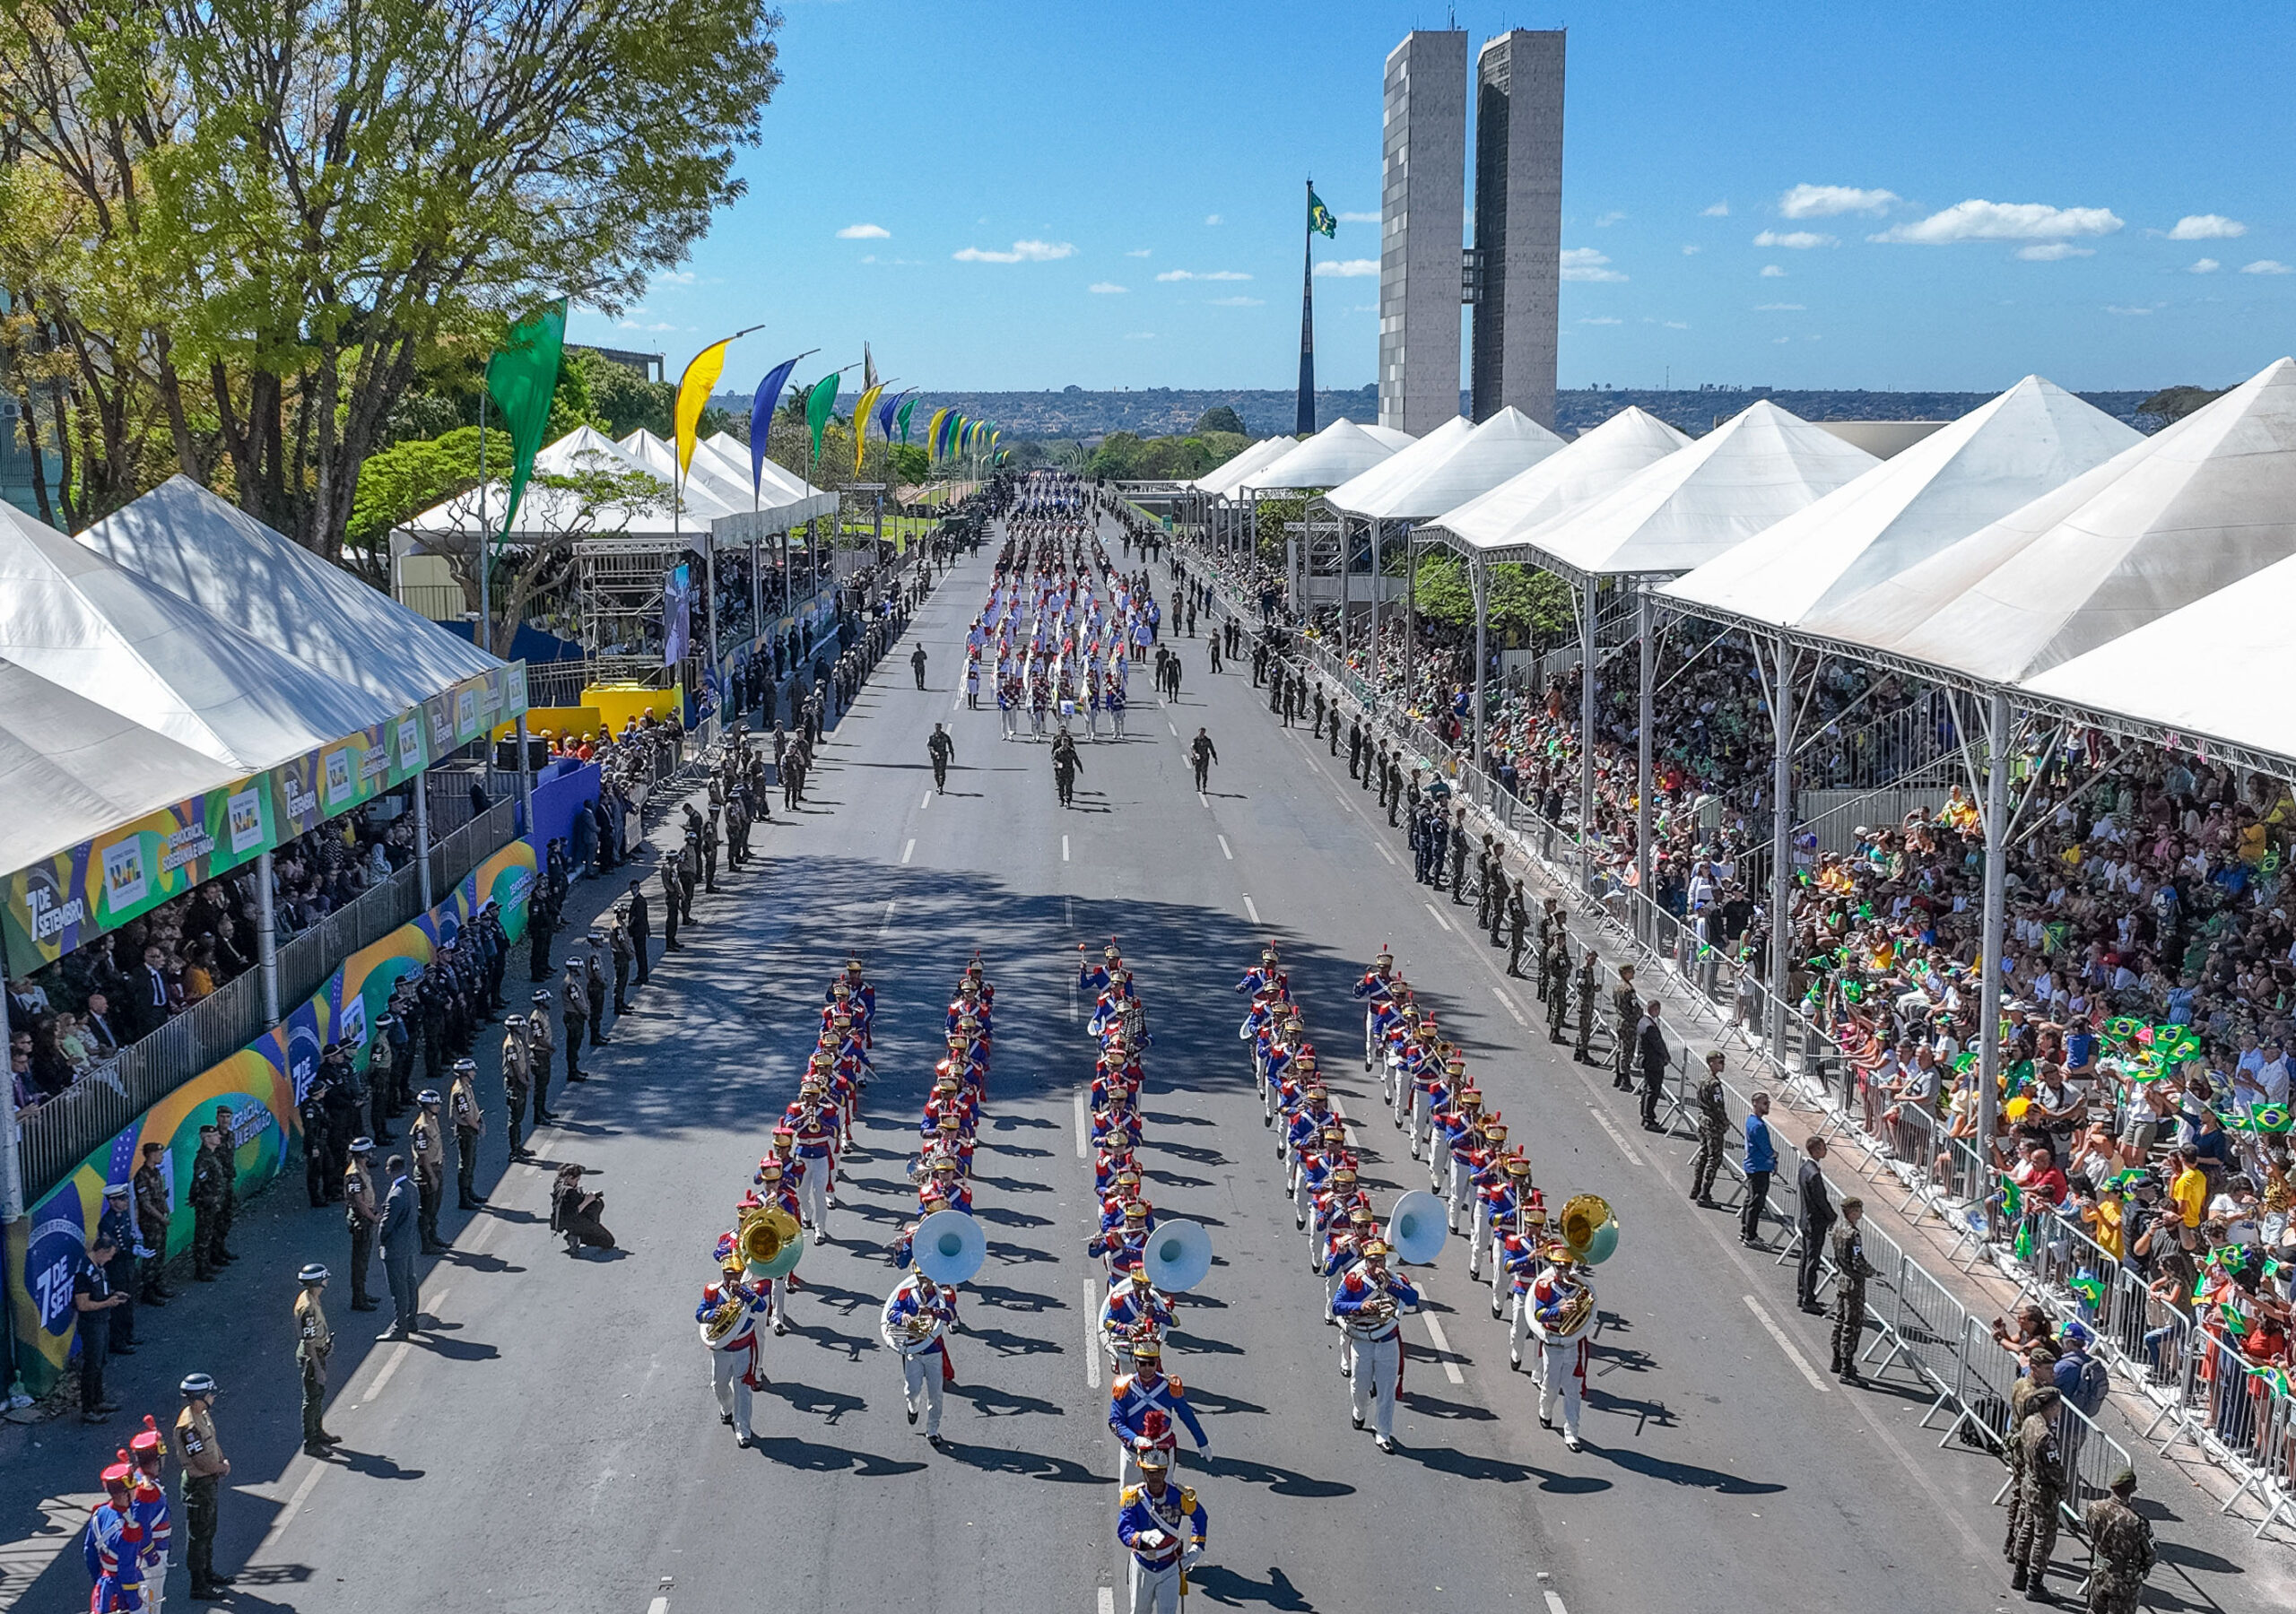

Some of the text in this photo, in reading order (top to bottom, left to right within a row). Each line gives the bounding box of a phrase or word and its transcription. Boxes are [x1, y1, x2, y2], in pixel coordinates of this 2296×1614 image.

[26, 885, 52, 942] 7 DE
[38, 898, 84, 939] SETEMBRO
[371, 1054, 382, 1062] PE
[507, 1053, 517, 1062] PE
[292, 1063, 301, 1107] 7
[458, 1103, 469, 1112] PE
[415, 1140, 427, 1149] PE
[348, 1183, 361, 1193] PE
[37, 1255, 67, 1329] 7 DE
[303, 1326, 316, 1337] PE
[186, 1439, 204, 1454] PE
